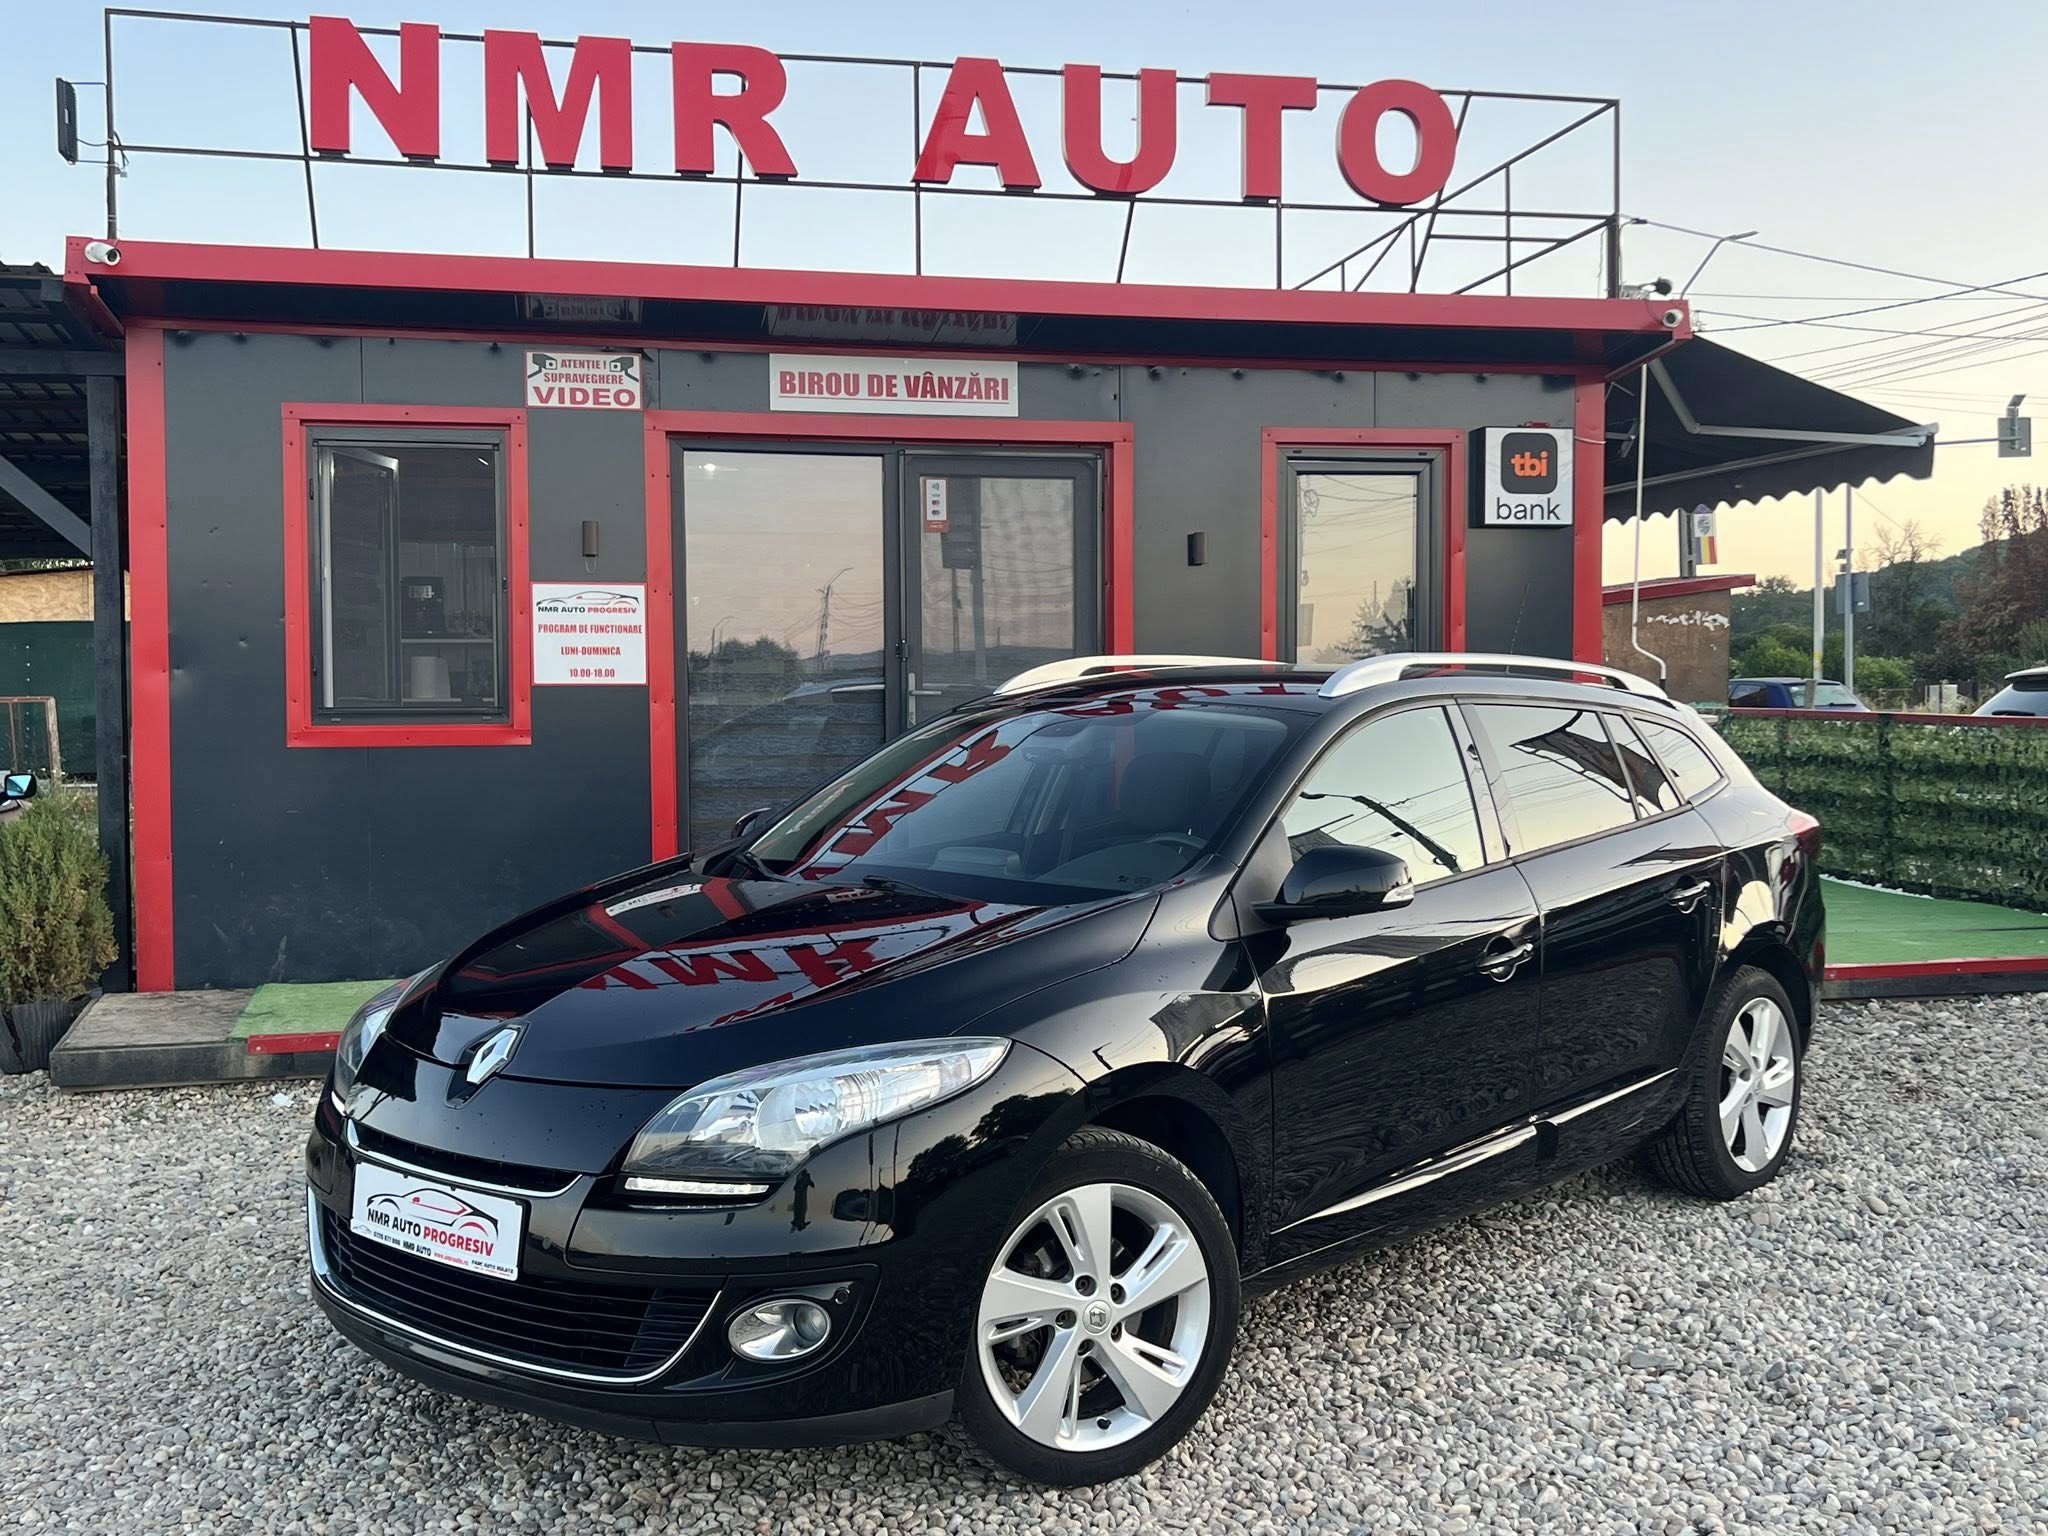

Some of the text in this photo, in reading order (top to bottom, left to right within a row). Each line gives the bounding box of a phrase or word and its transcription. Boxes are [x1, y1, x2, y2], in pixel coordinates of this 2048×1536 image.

[310, 15, 1458, 206] NMR AUTO
[543, 373, 624, 385] SUPRAVEGHERE
[779, 371, 1009, 401] BIROU DE VÂNZĂRI
[533, 386, 636, 407] VIDEO
[1510, 450, 1548, 477] tbi
[1496, 497, 1560, 520] bank
[538, 623, 578, 633] PROGRAM
[579, 624, 588, 633] DE
[560, 646, 621, 656] LUNI-DUMINICA
[569, 668, 615, 678] 10.00-18.00
[367, 1208, 390, 1228] NMR
[391, 1218, 421, 1238] AUTO
[423, 1226, 495, 1257] PROGRESIV
